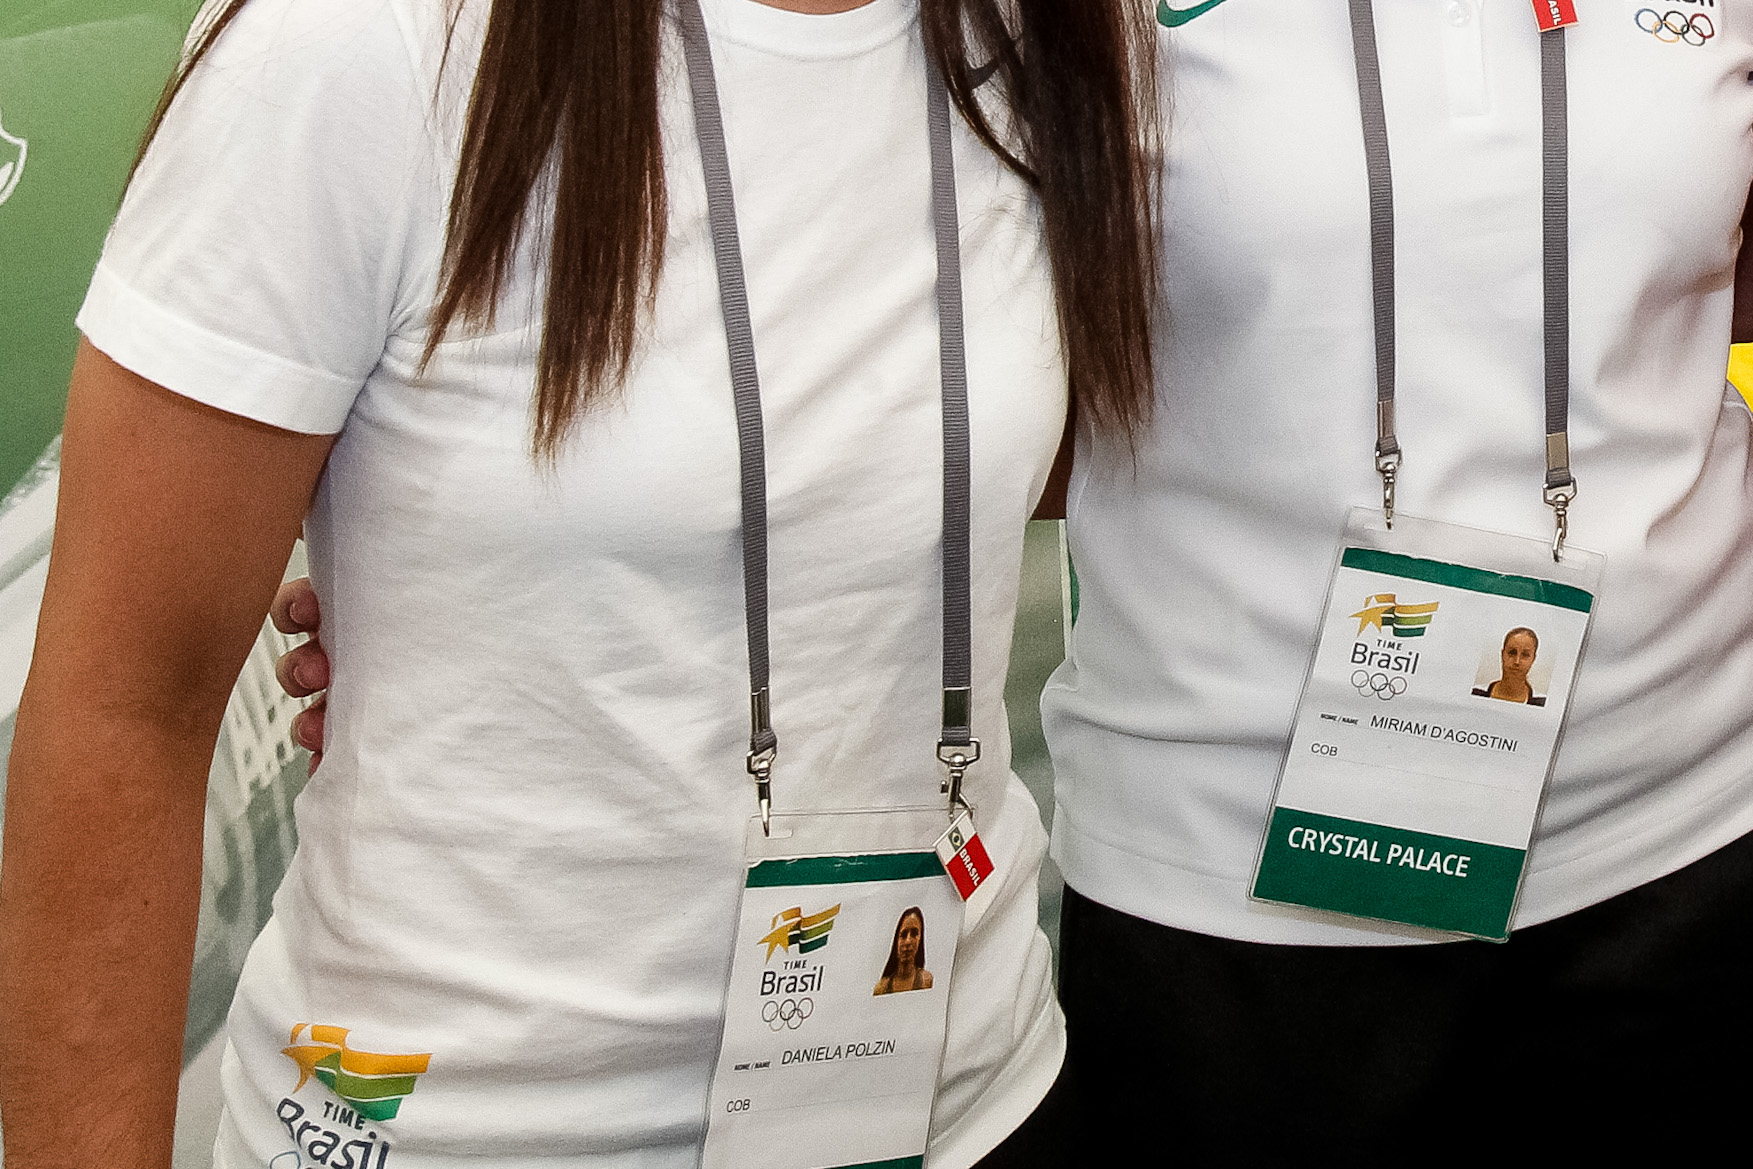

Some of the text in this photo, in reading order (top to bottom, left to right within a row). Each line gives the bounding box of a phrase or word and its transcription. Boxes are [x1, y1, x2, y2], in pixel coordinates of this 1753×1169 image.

[1350, 642, 1420, 674] Brasil
[1376, 638, 1403, 651] TIME
[1370, 715, 1518, 752] MIRIAM D'AGOSTINI
[1311, 743, 1338, 757] COB
[1287, 826, 1471, 879] CRYSTAL PALACE
[959, 848, 981, 887] BRASIL
[783, 959, 808, 971] TIME
[760, 965, 824, 996] Brasil
[781, 1039, 896, 1065] DANIELA POLZIN
[323, 1101, 366, 1130] TIME
[726, 1098, 751, 1113] COB
